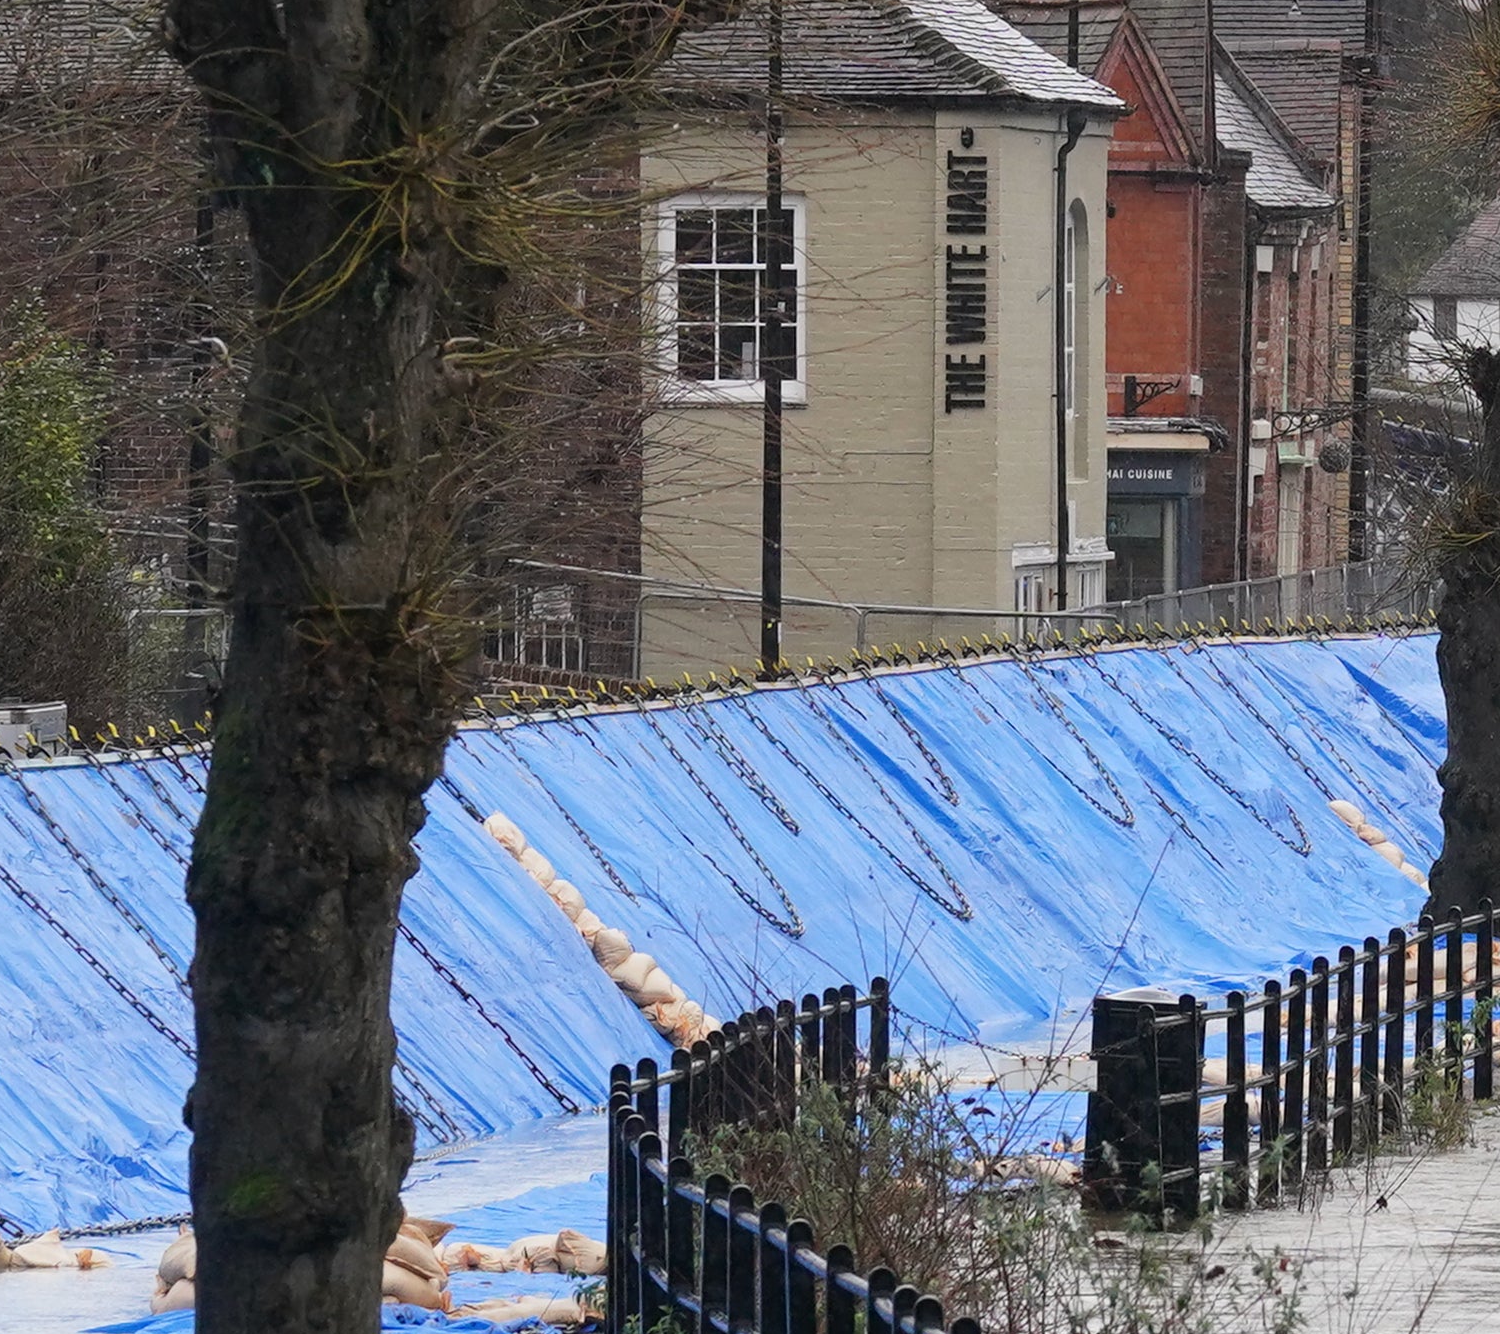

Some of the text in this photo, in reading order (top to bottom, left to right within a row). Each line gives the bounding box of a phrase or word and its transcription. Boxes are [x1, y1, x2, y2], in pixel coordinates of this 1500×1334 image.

[945, 150, 988, 414] THE WHITE HART
[1127, 468, 1173, 479] CUISINE
